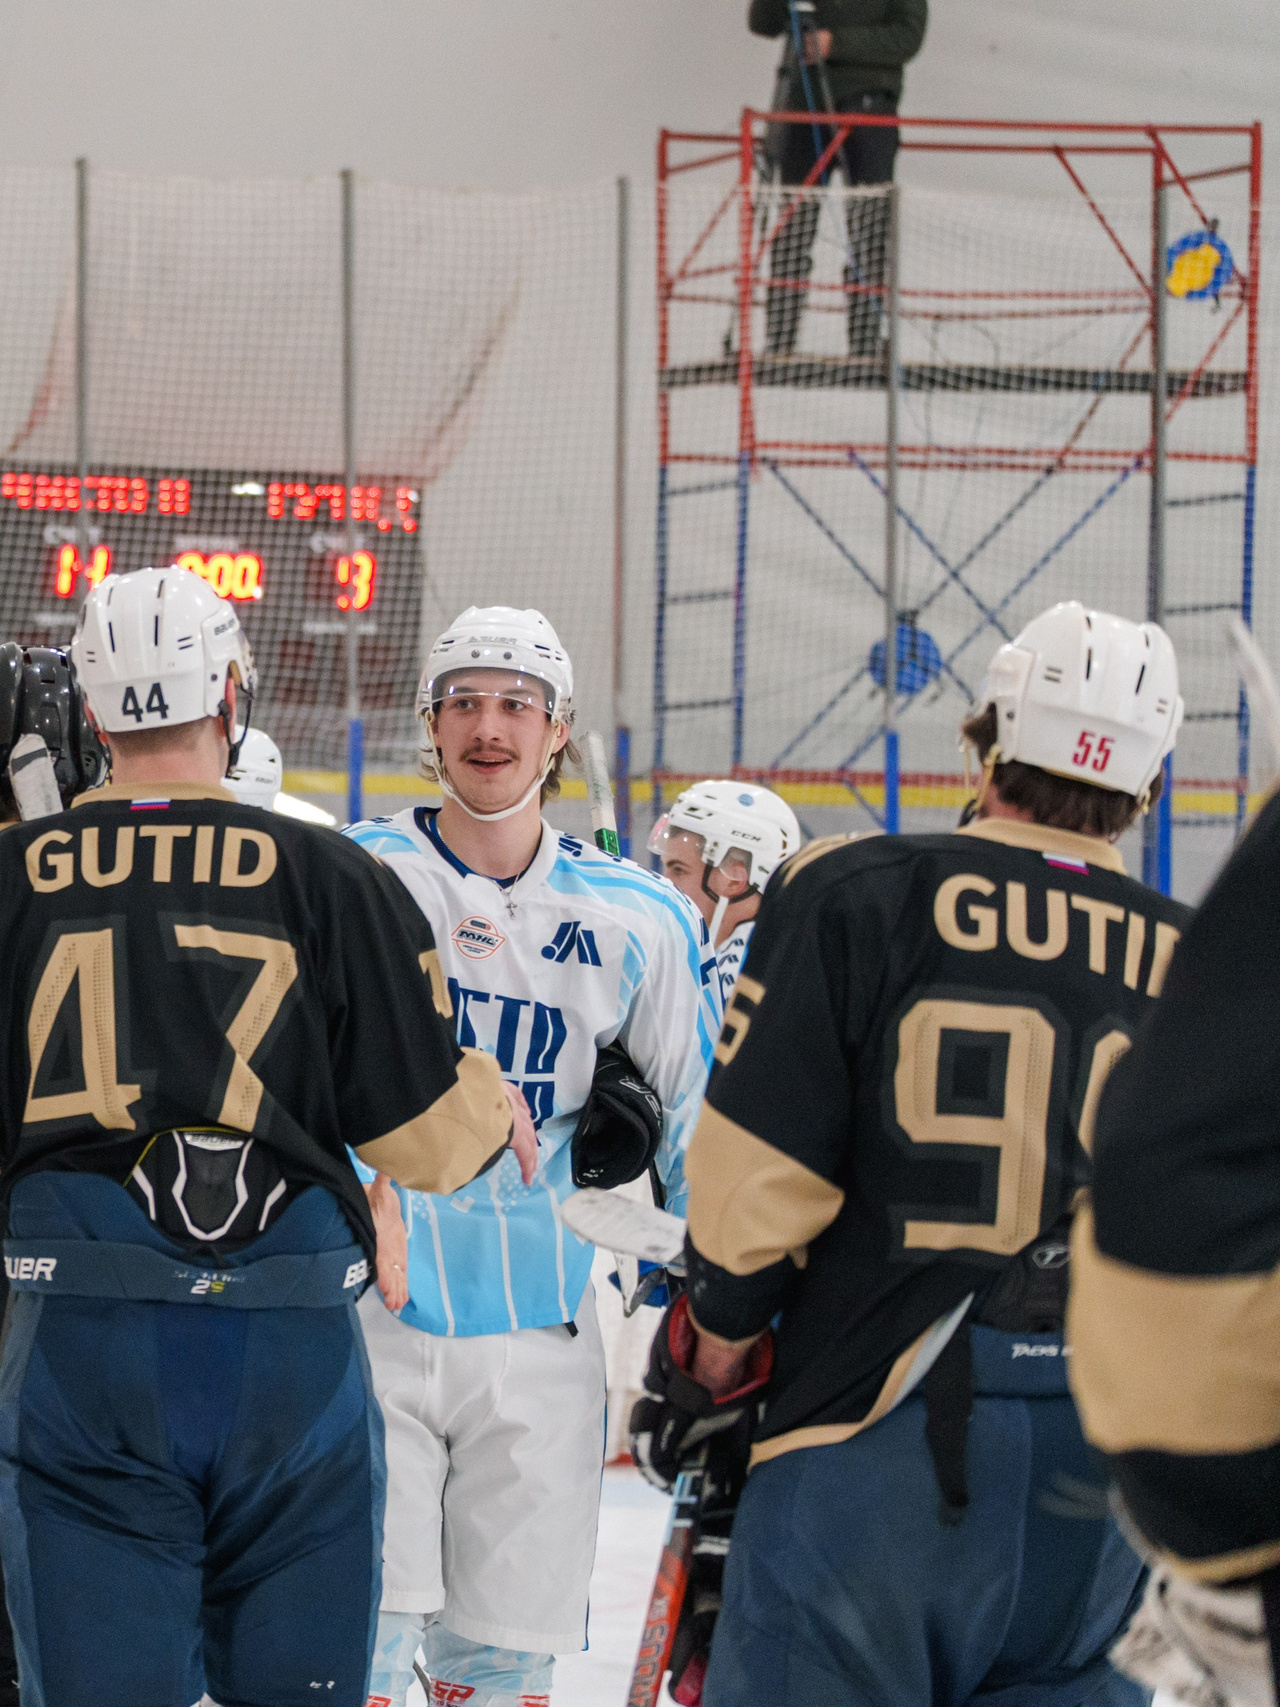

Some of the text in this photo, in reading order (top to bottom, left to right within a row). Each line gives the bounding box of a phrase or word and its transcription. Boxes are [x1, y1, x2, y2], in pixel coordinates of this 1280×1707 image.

[122, 682, 169, 722] 44
[1072, 730, 1115, 772] 55
[730, 829, 762, 842] CCM
[25, 824, 278, 893] GUTID
[22, 921, 298, 1132] 47
